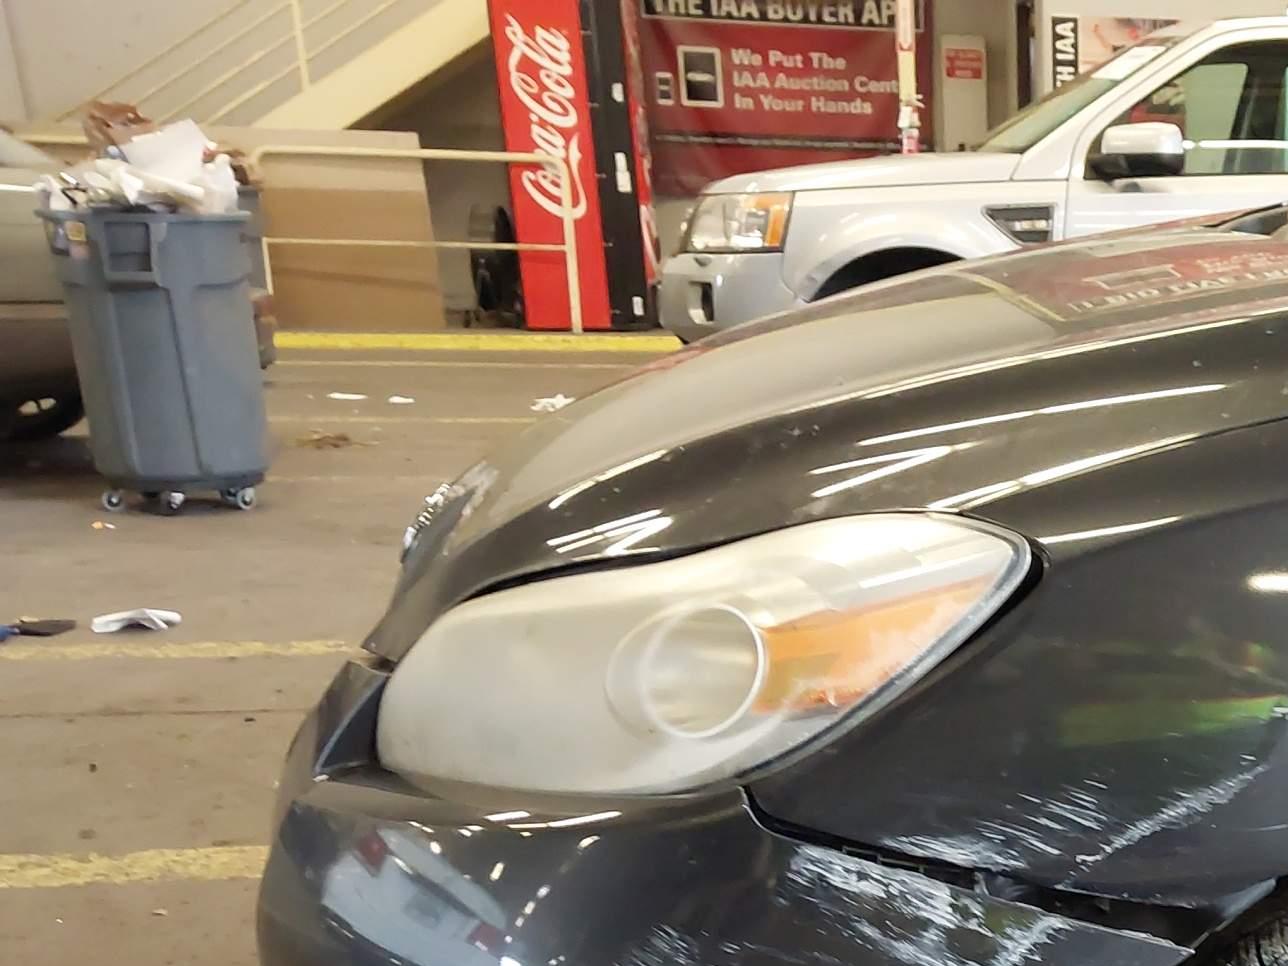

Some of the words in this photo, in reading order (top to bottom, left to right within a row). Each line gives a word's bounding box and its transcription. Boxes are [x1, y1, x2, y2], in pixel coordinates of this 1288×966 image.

[710, 0, 760, 19] IAA
[767, 0, 855, 23] BUYER
[1055, 21, 1075, 60] IAA
[731, 48, 762, 66] We
[768, 50, 803, 69] Put
[808, 52, 847, 70] The
[732, 71, 770, 89] IAA
[774, 73, 849, 92] Auction
[734, 93, 754, 110] In
[760, 94, 804, 111] Your
[811, 96, 872, 114] Hands
